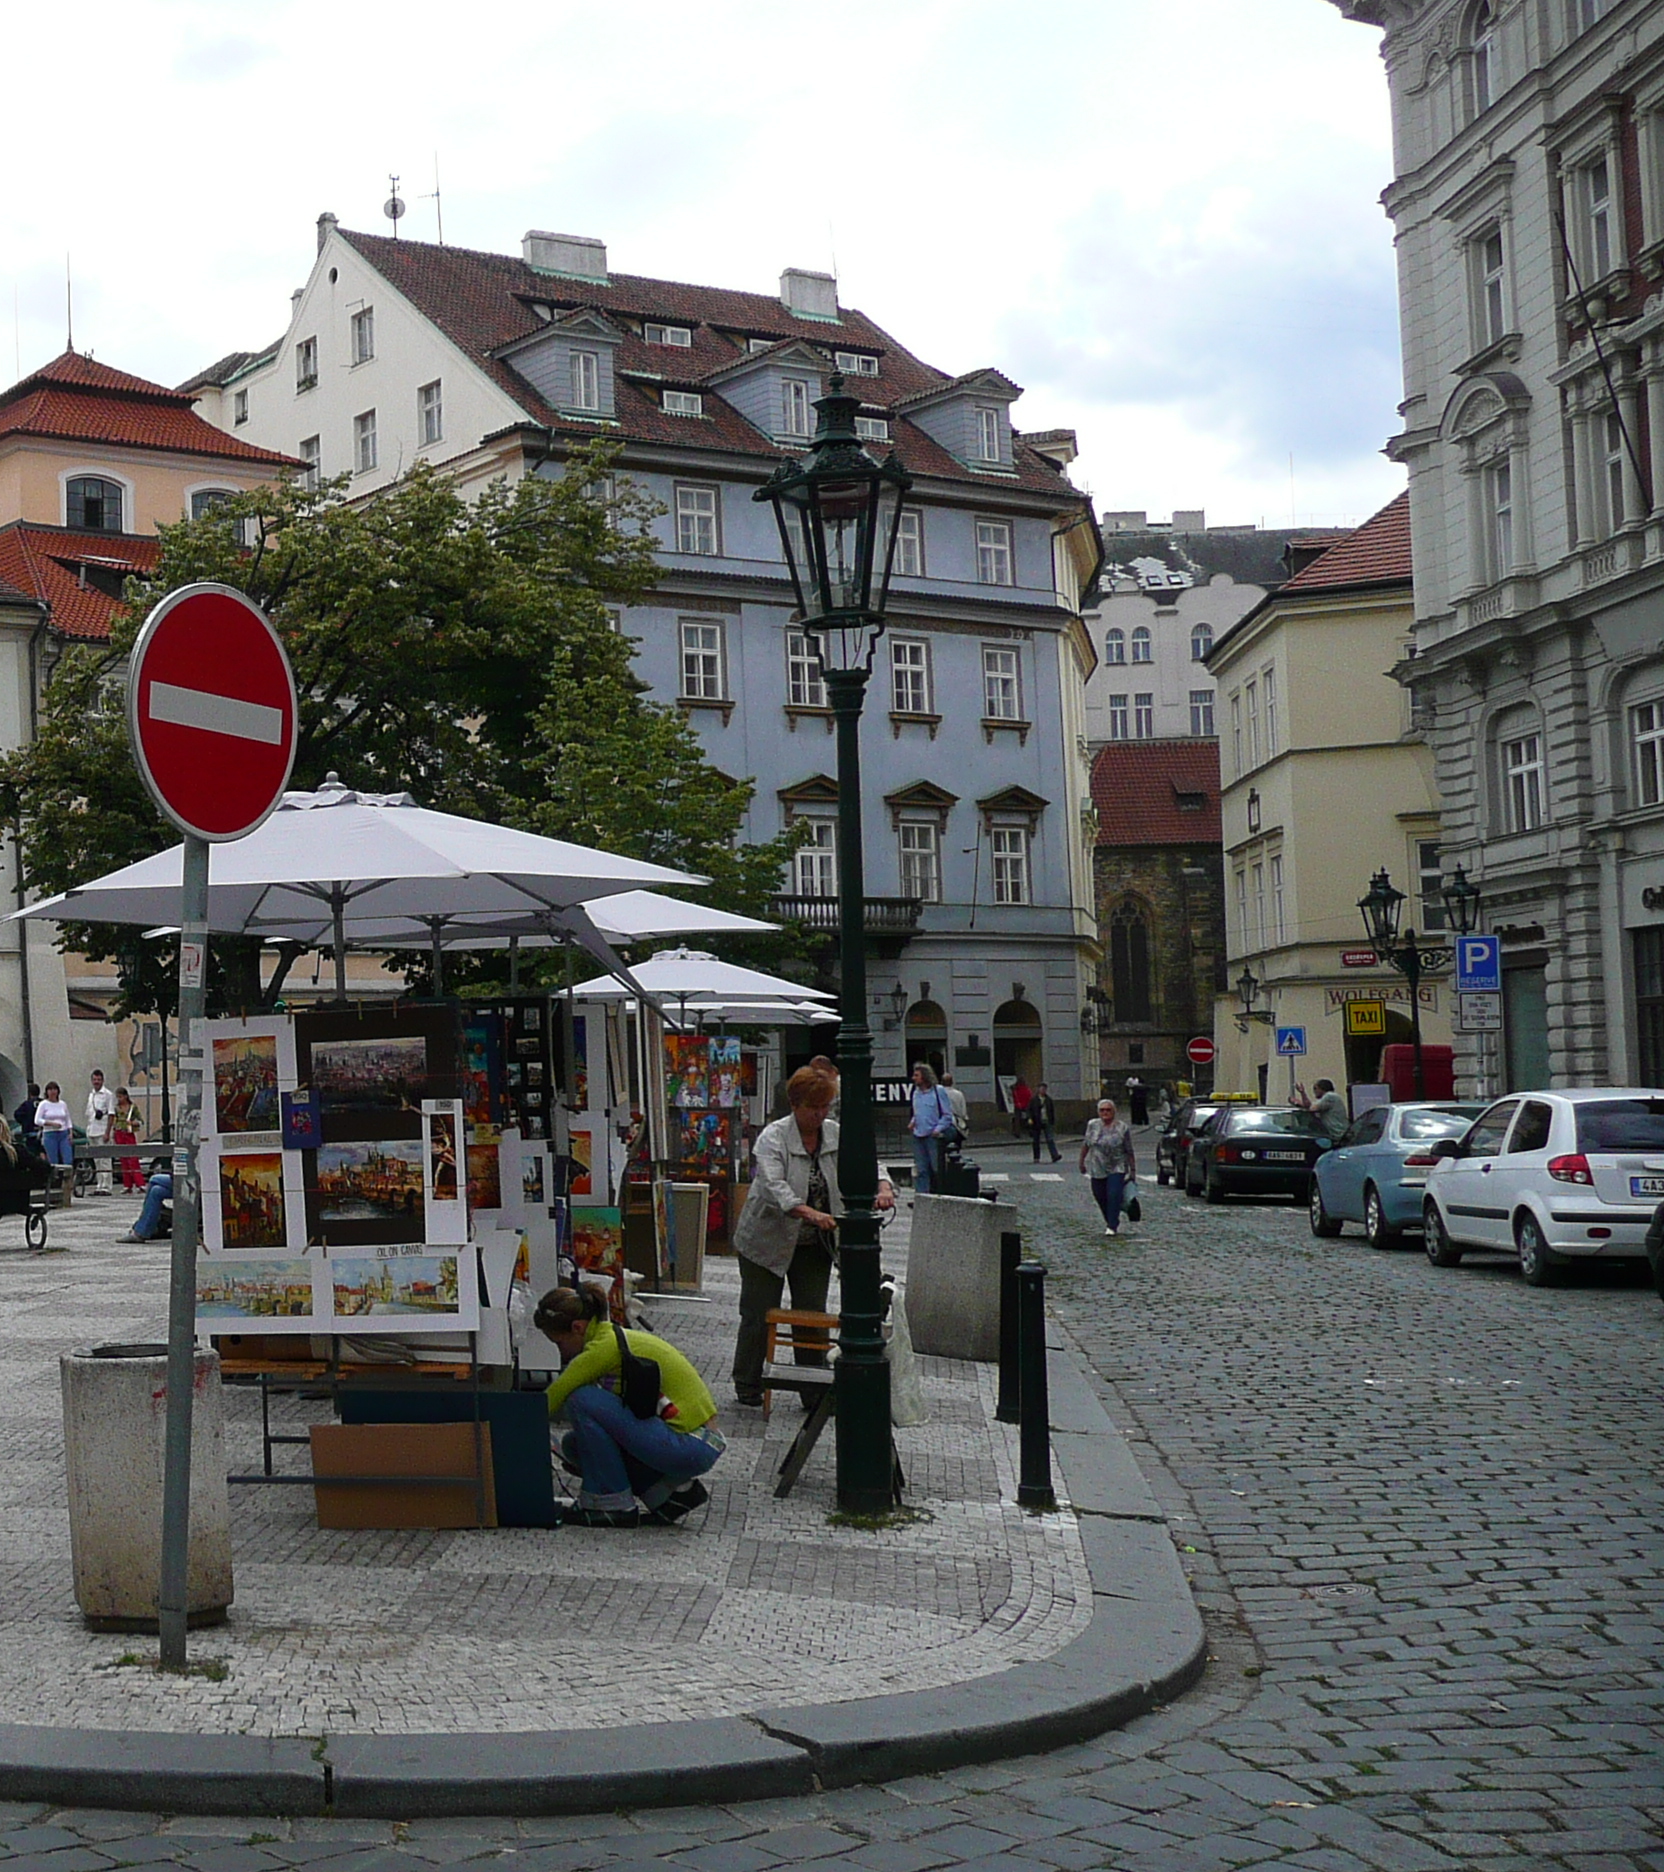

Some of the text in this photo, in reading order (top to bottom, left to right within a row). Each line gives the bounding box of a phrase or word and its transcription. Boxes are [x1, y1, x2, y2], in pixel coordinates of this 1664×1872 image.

[1465, 943, 1490, 973] P
[1353, 1010, 1378, 1024] TAXI
[870, 1083, 914, 1102] ENY
